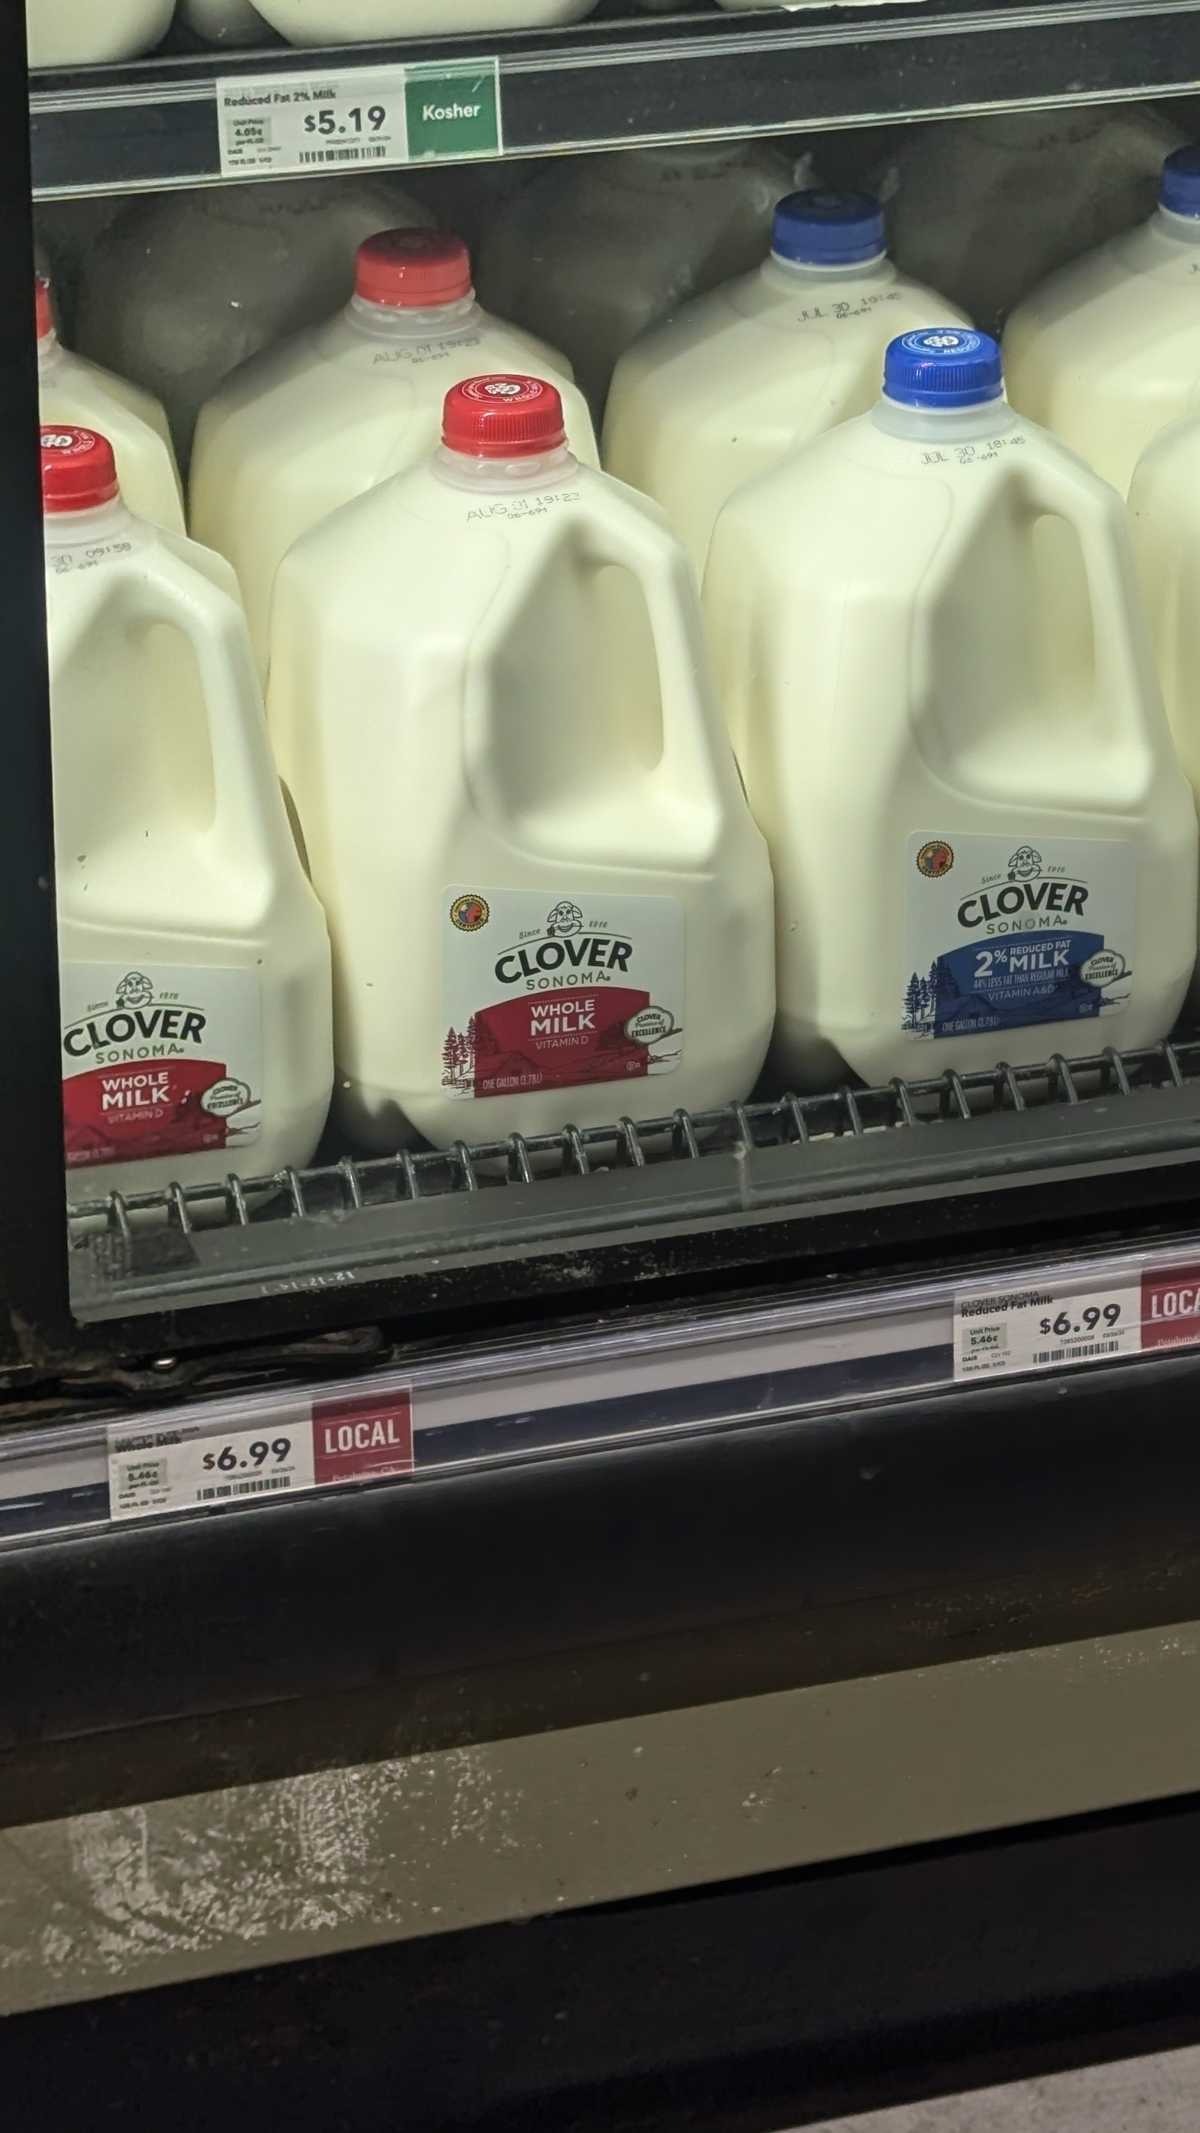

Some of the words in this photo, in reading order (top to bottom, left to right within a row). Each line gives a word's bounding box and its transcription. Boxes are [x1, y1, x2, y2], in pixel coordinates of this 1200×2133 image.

[224, 93, 271, 106] Reduced
[274, 94, 291, 103] Fat
[293, 92, 310, 102] 2%
[313, 89, 336, 99] Milk
[304, 106, 386, 135] $5.19
[422, 103, 481, 121] Kosher
[957, 882, 1090, 928] CLOVER
[985, 914, 1063, 935] SONOMA
[1009, 942, 1055, 956] REDUCED
[494, 938, 633, 985] CLOVER
[973, 951, 1008, 978] 2%
[1009, 949, 1070, 974] MILK
[526, 971, 606, 991] SONOMA
[988, 988, 1030, 1002] VITAMIN
[531, 1000, 595, 1018] WHOLE
[63, 1009, 206, 1057] CLOVER
[531, 1013, 596, 1037] MILK
[535, 1038, 579, 1050] VITAMIN
[581, 1035, 589, 1045] D
[95, 1044, 177, 1065] SONOMA
[102, 1071, 169, 1091] WHOLE
[102, 1086, 170, 1111] MILK
[155, 1109, 164, 1119] D
[961, 1303, 1007, 1318] Reduced
[1039, 1303, 1121, 1336] $6.99
[325, 1419, 400, 1453] LOCAL
[202, 1438, 291, 1471] $6.99
